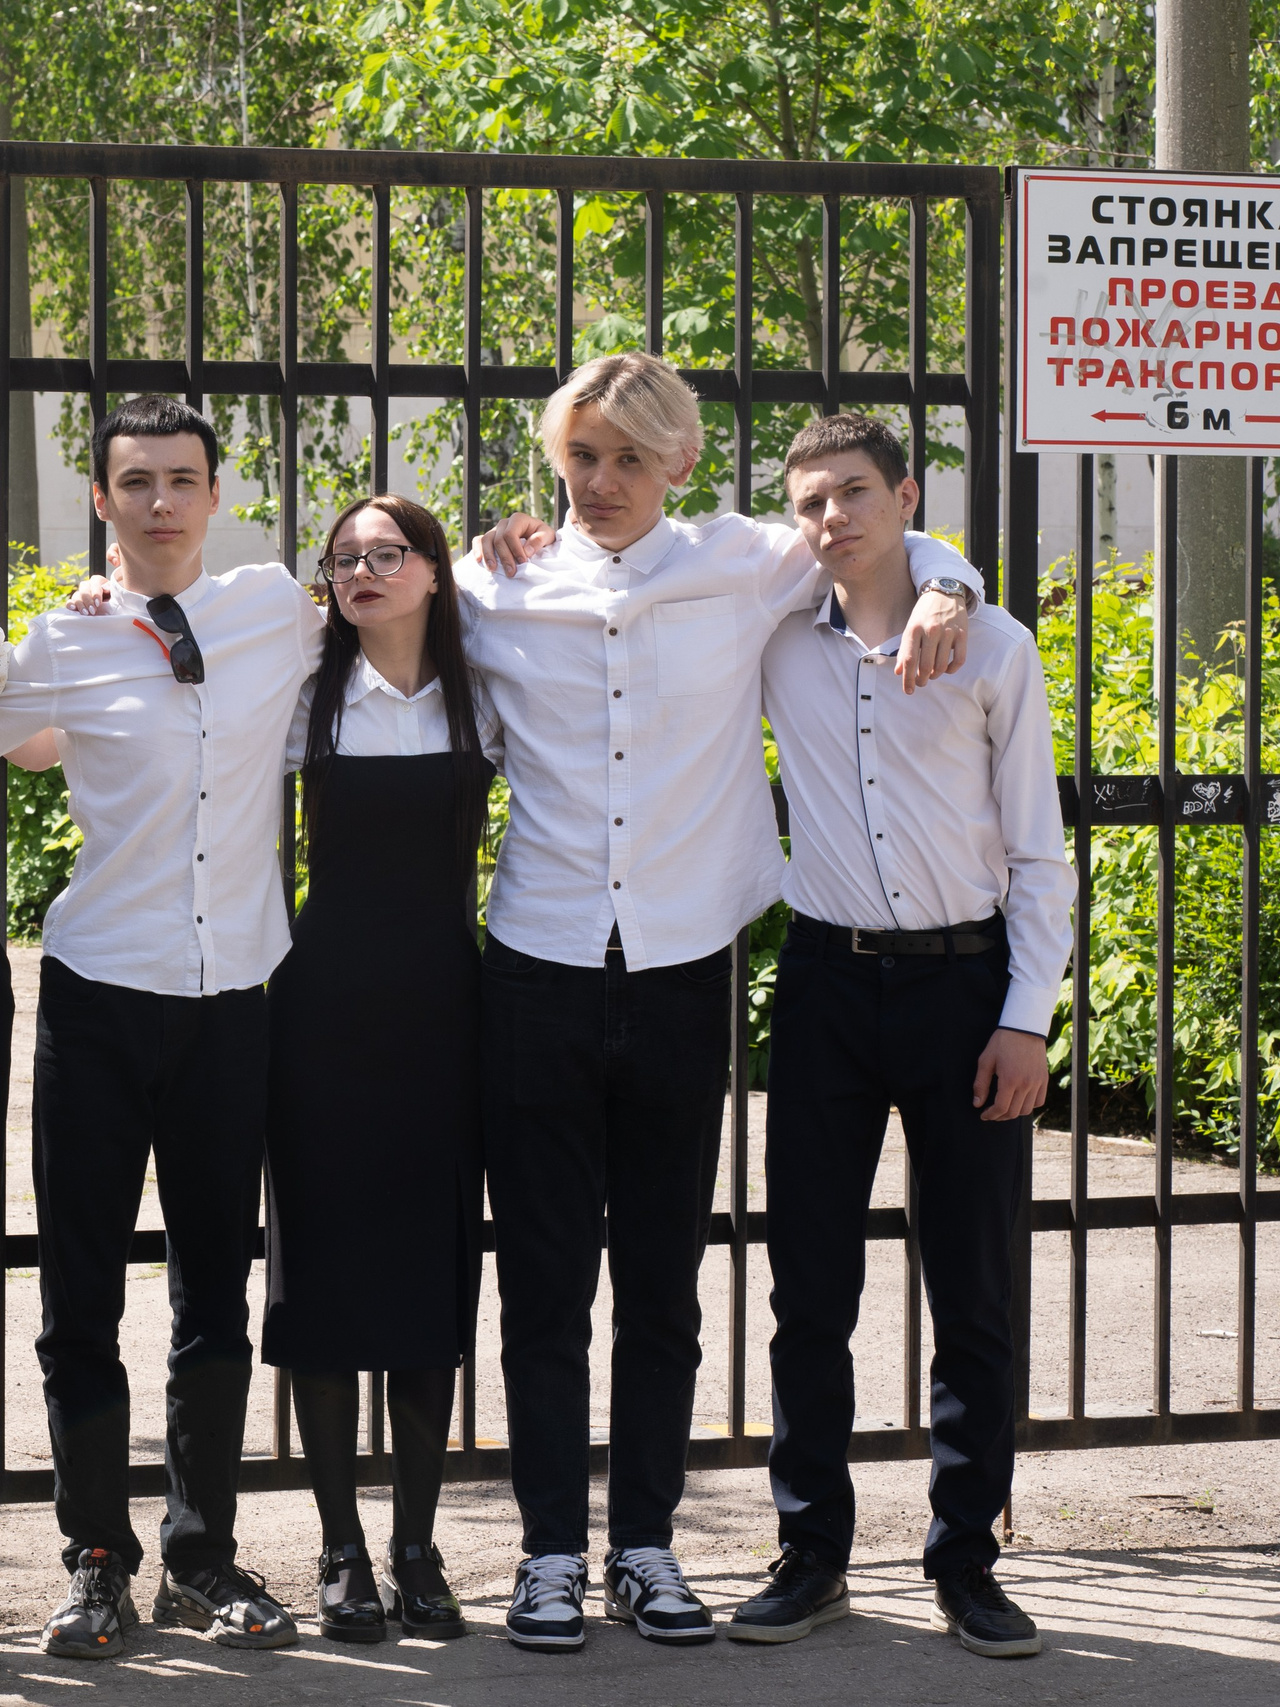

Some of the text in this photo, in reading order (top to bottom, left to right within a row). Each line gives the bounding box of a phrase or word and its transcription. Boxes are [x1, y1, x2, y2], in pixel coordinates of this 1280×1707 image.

[1092, 195, 1280, 230] СТОЯНК
[1047, 234, 1280, 270] ЗАПРЕЩЕ
[1166, 401, 1231, 431] 6 м
